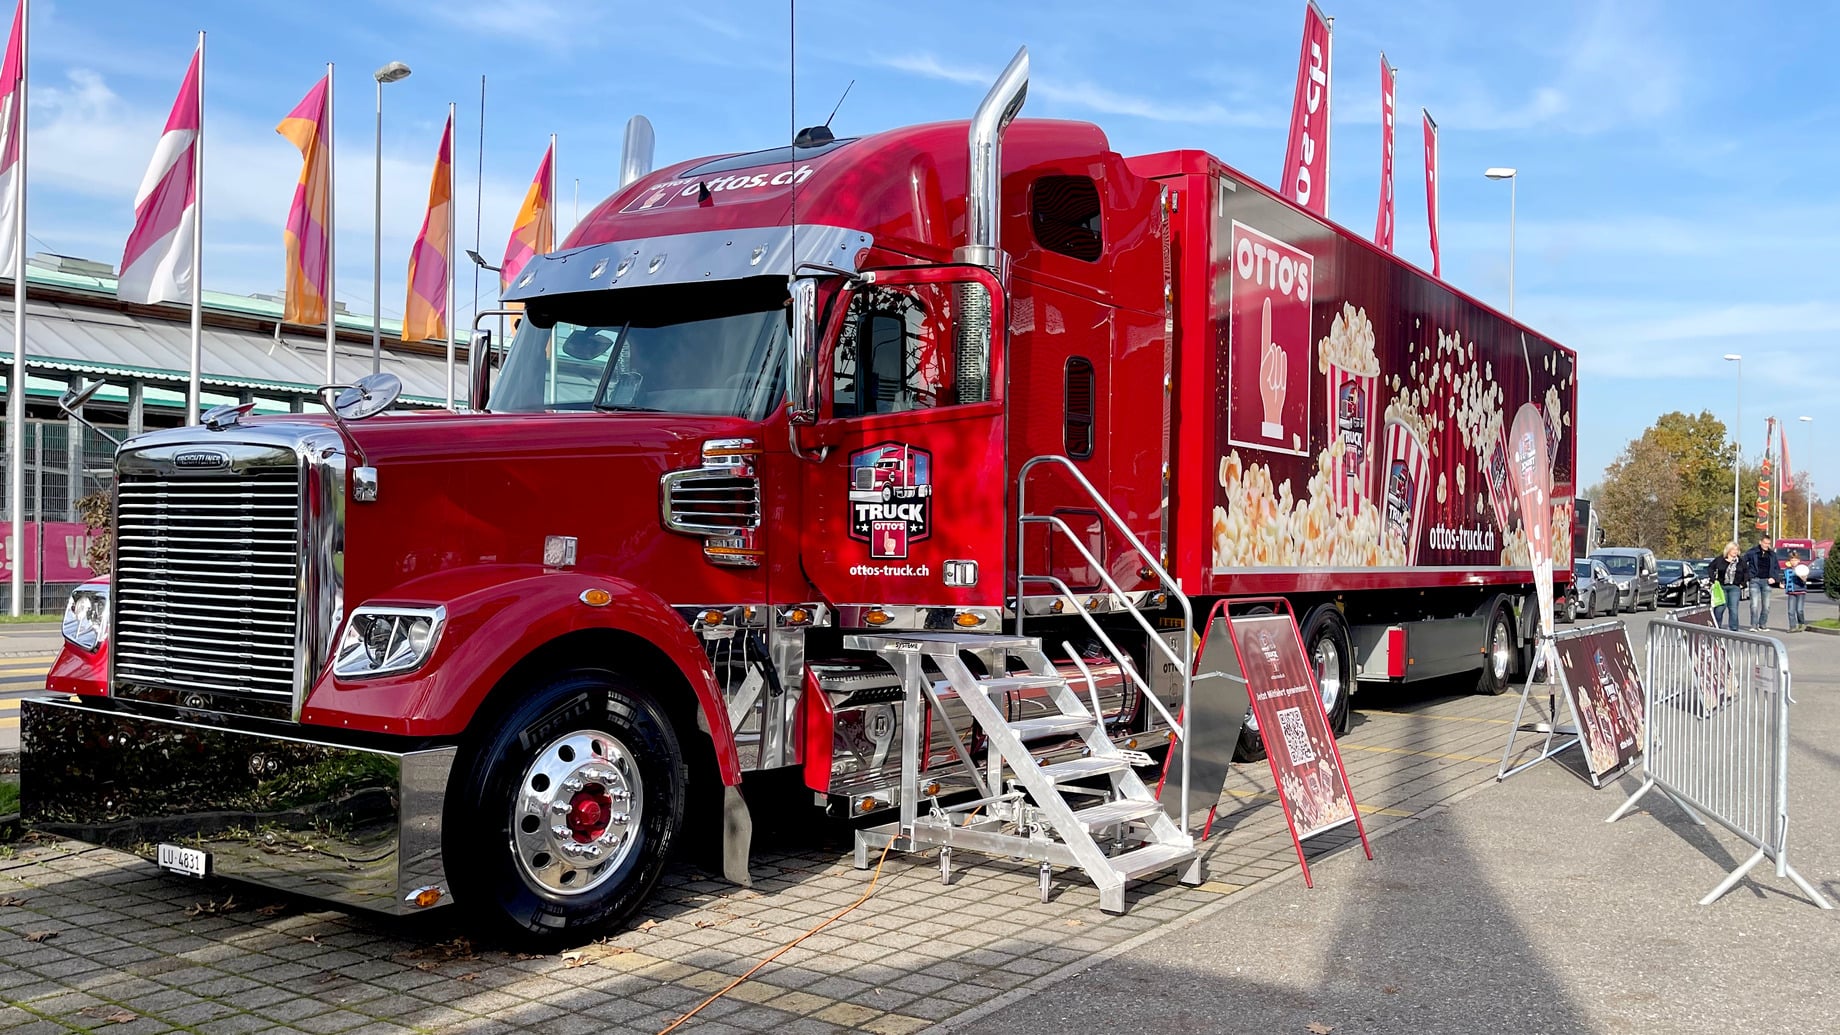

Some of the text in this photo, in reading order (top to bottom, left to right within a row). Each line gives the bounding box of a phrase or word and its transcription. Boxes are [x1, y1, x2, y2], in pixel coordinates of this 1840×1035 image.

[681, 164, 814, 197] ottos.ch
[1236, 237, 1309, 302] OTTO'S
[855, 503, 924, 523] TRUCK
[874, 522, 905, 531] OTTO'S
[1429, 522, 1495, 551] ottos-truck.ch
[849, 564, 930, 577] ottos-truck.ch
